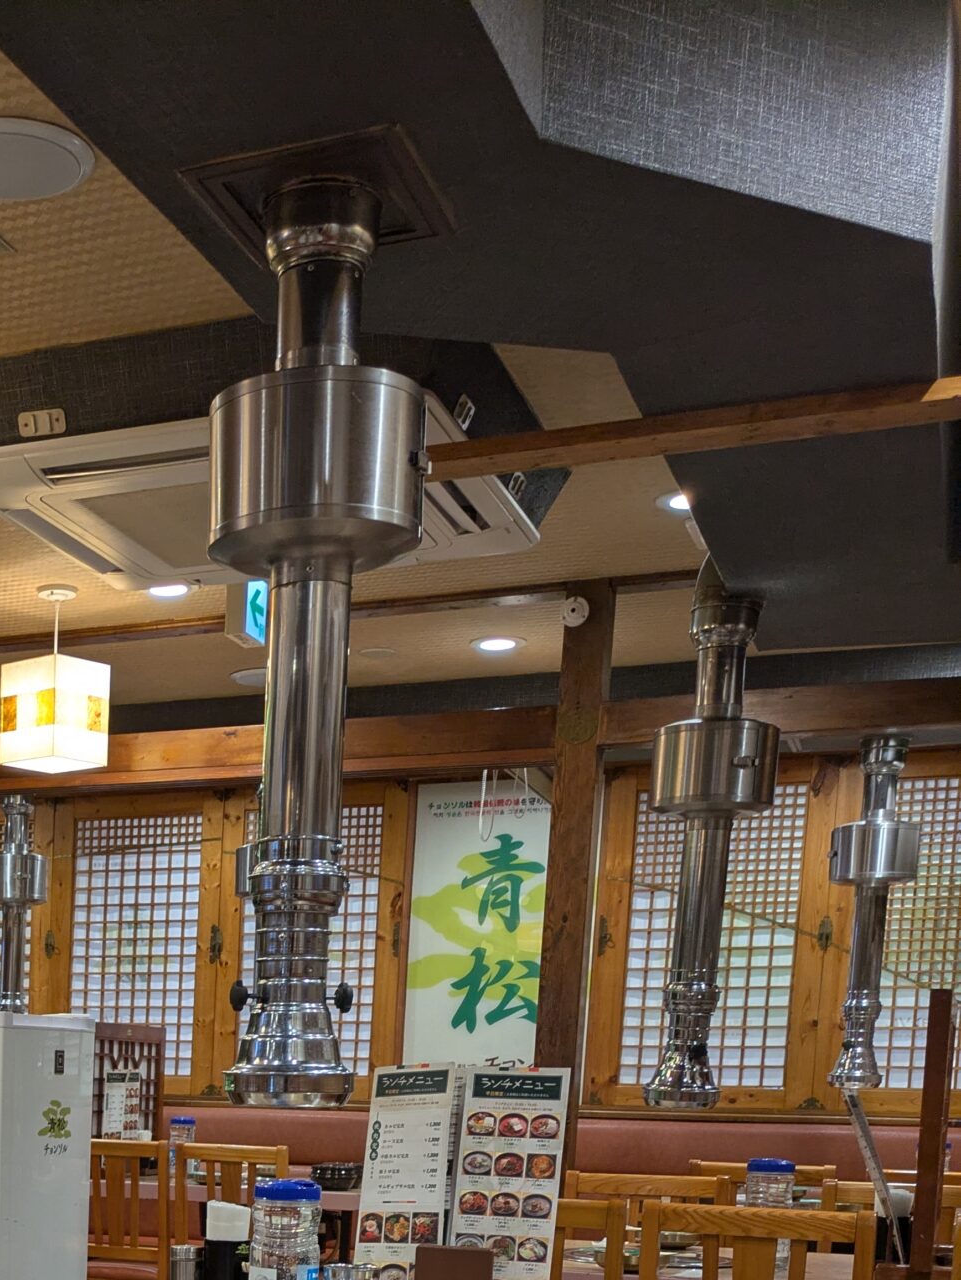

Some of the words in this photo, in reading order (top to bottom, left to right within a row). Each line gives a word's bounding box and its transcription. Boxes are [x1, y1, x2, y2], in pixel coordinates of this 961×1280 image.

[451, 834, 545, 1034] 青松
[382, 1075, 444, 1088] ランチメニュー
[481, 1077, 557, 1090] ランチメニュー
